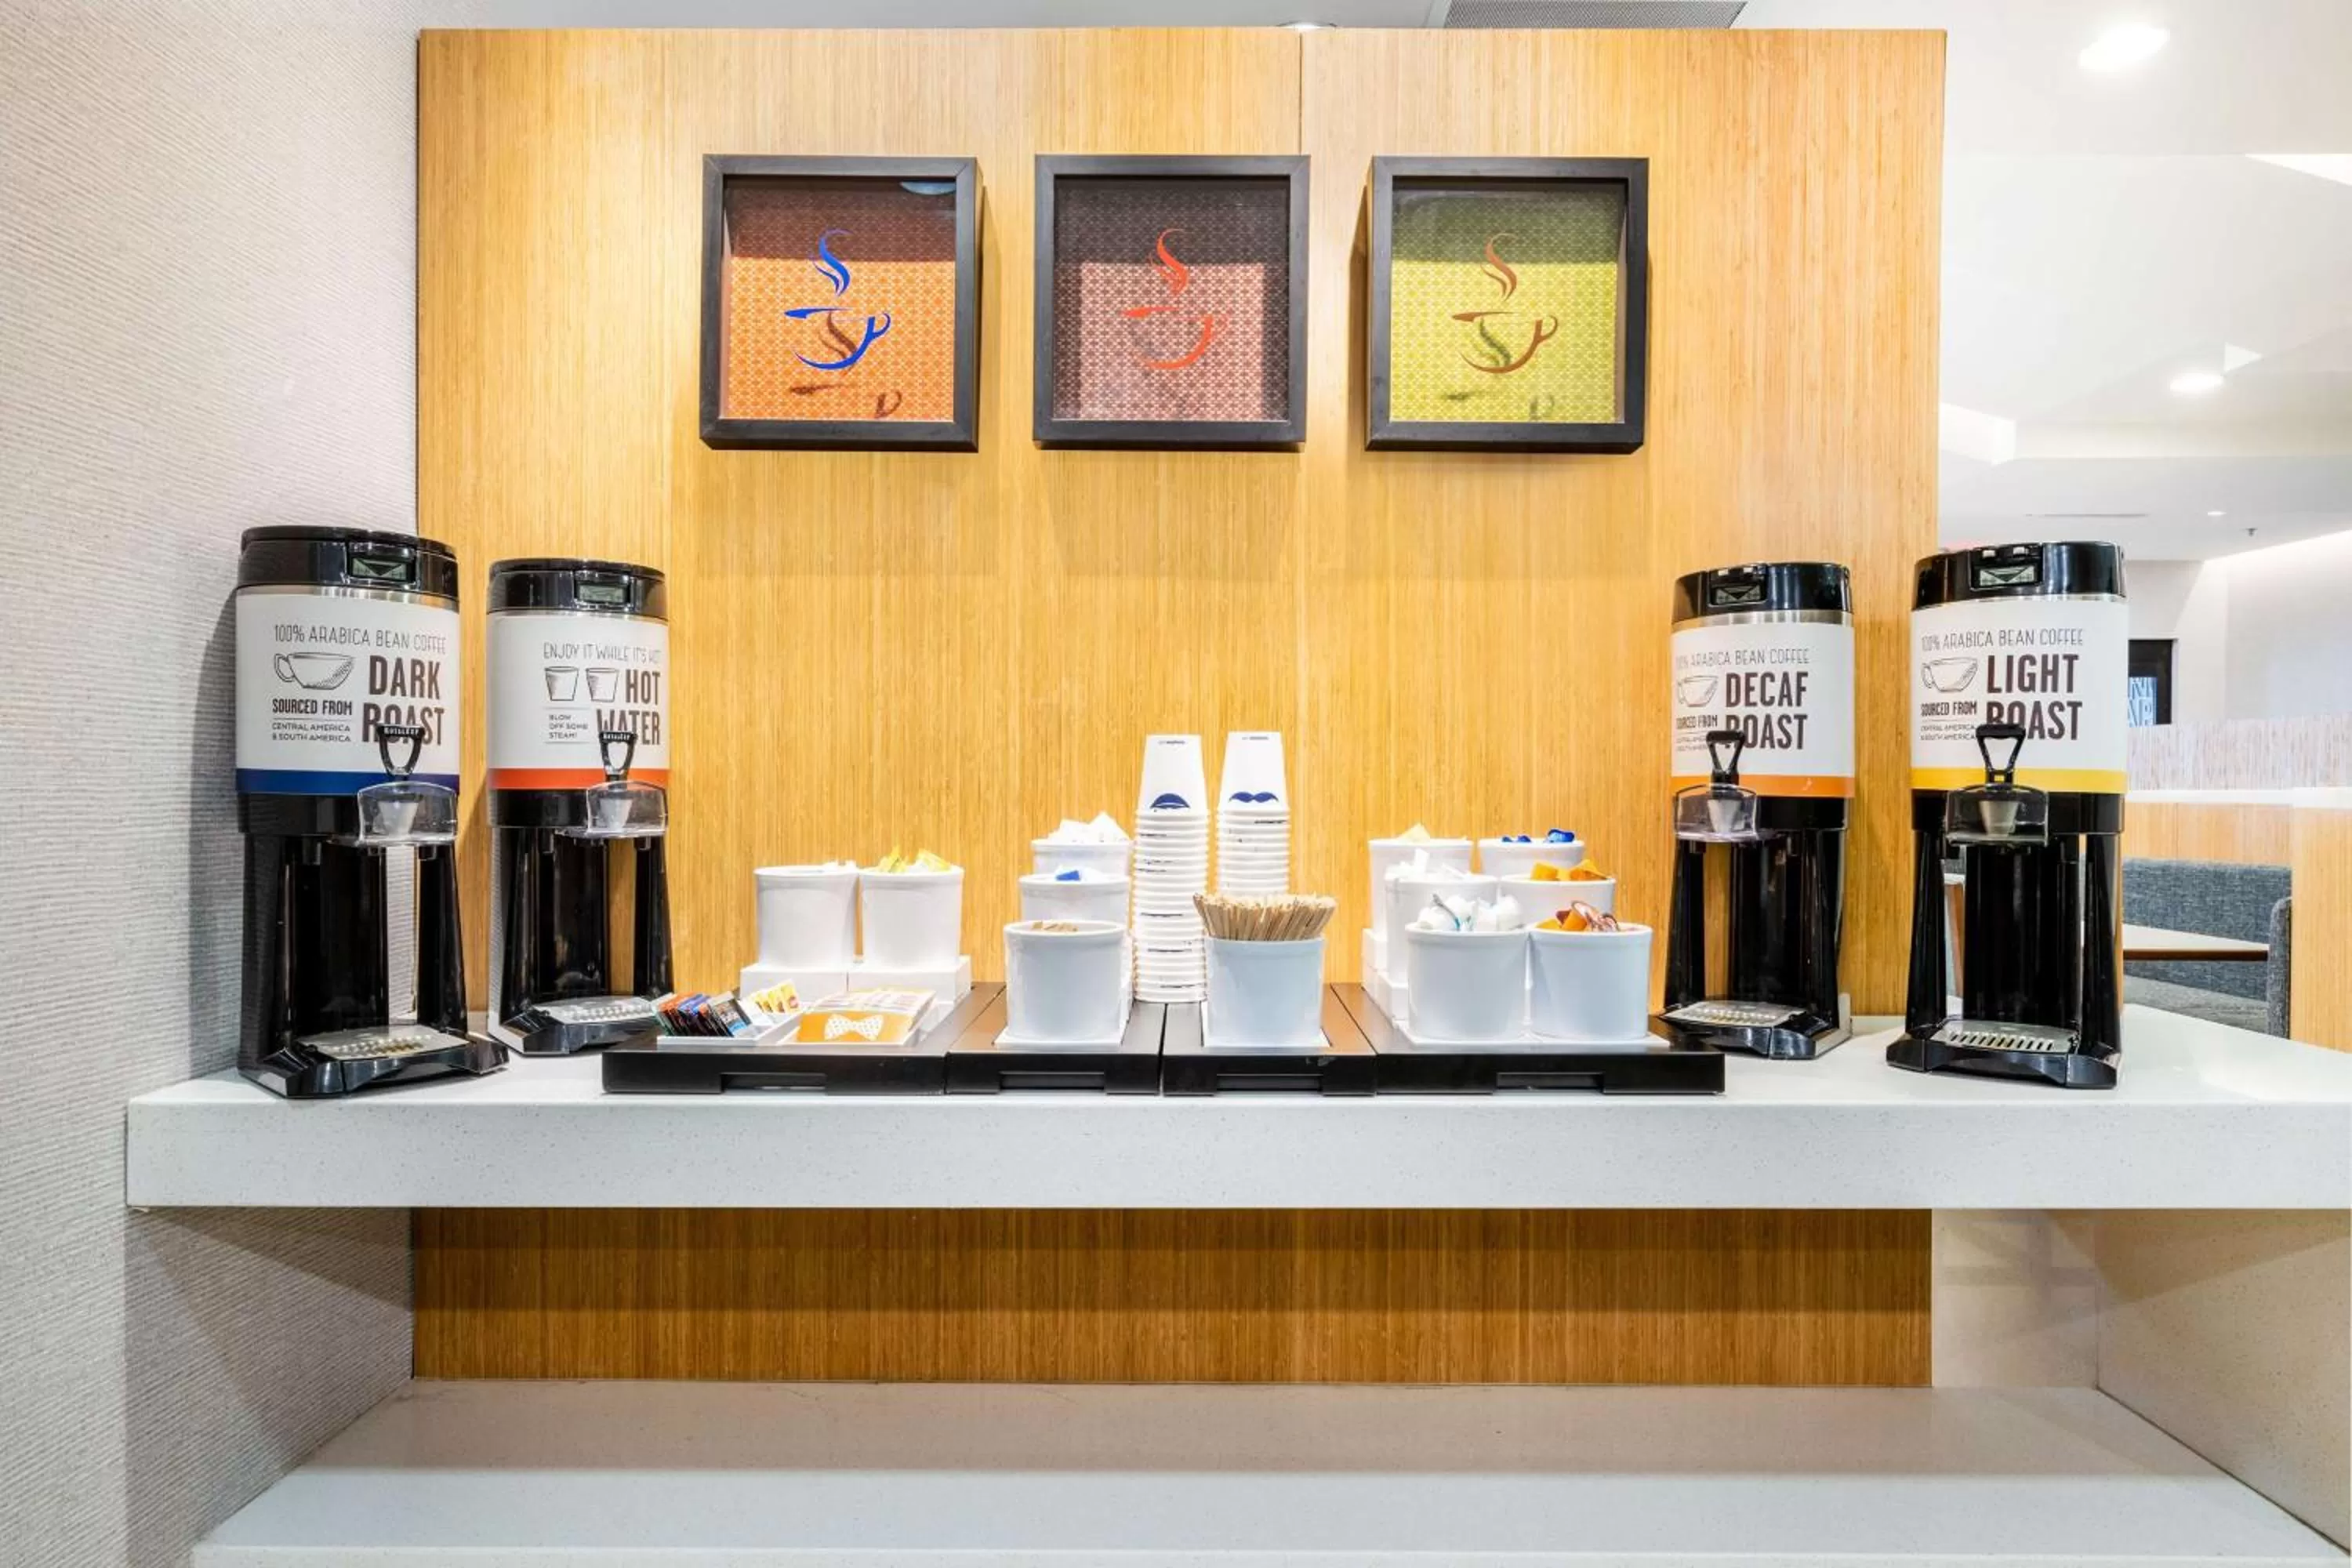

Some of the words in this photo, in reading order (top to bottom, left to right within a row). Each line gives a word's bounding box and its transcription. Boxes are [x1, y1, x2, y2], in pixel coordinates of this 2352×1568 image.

[275, 625, 304, 643] 100%
[308, 626, 370, 646] ARABICA
[376, 630, 410, 649] BEAN
[413, 633, 446, 654] COFFEE
[543, 641, 579, 659] ENJOY
[583, 643, 595, 659] IT
[596, 644, 630, 662] WHILE
[1943, 631, 1994, 650] ARABICA
[1999, 629, 2034, 647] BEAN
[2039, 628, 2083, 647] COFFEE
[1735, 649, 1765, 665] BEAN
[1769, 648, 1809, 664] COFFEE
[368, 655, 441, 699] DARK
[626, 669, 661, 705] HOT
[1726, 671, 1809, 707] DECAF
[1987, 654, 2078, 693] LIGHT
[272, 699, 318, 715] SOURCED
[322, 700, 352, 715] FROM
[1921, 702, 1950, 717] SOURCED
[1953, 701, 1977, 715] FROM
[1986, 700, 2082, 740] ROAST
[272, 722, 309, 731] CENTRAL
[310, 723, 351, 732] AMERICA
[278, 732, 308, 742] SOUTH
[361, 702, 445, 746] ROAST
[597, 708, 660, 746] WATER
[1726, 713, 1808, 750] ROAST
